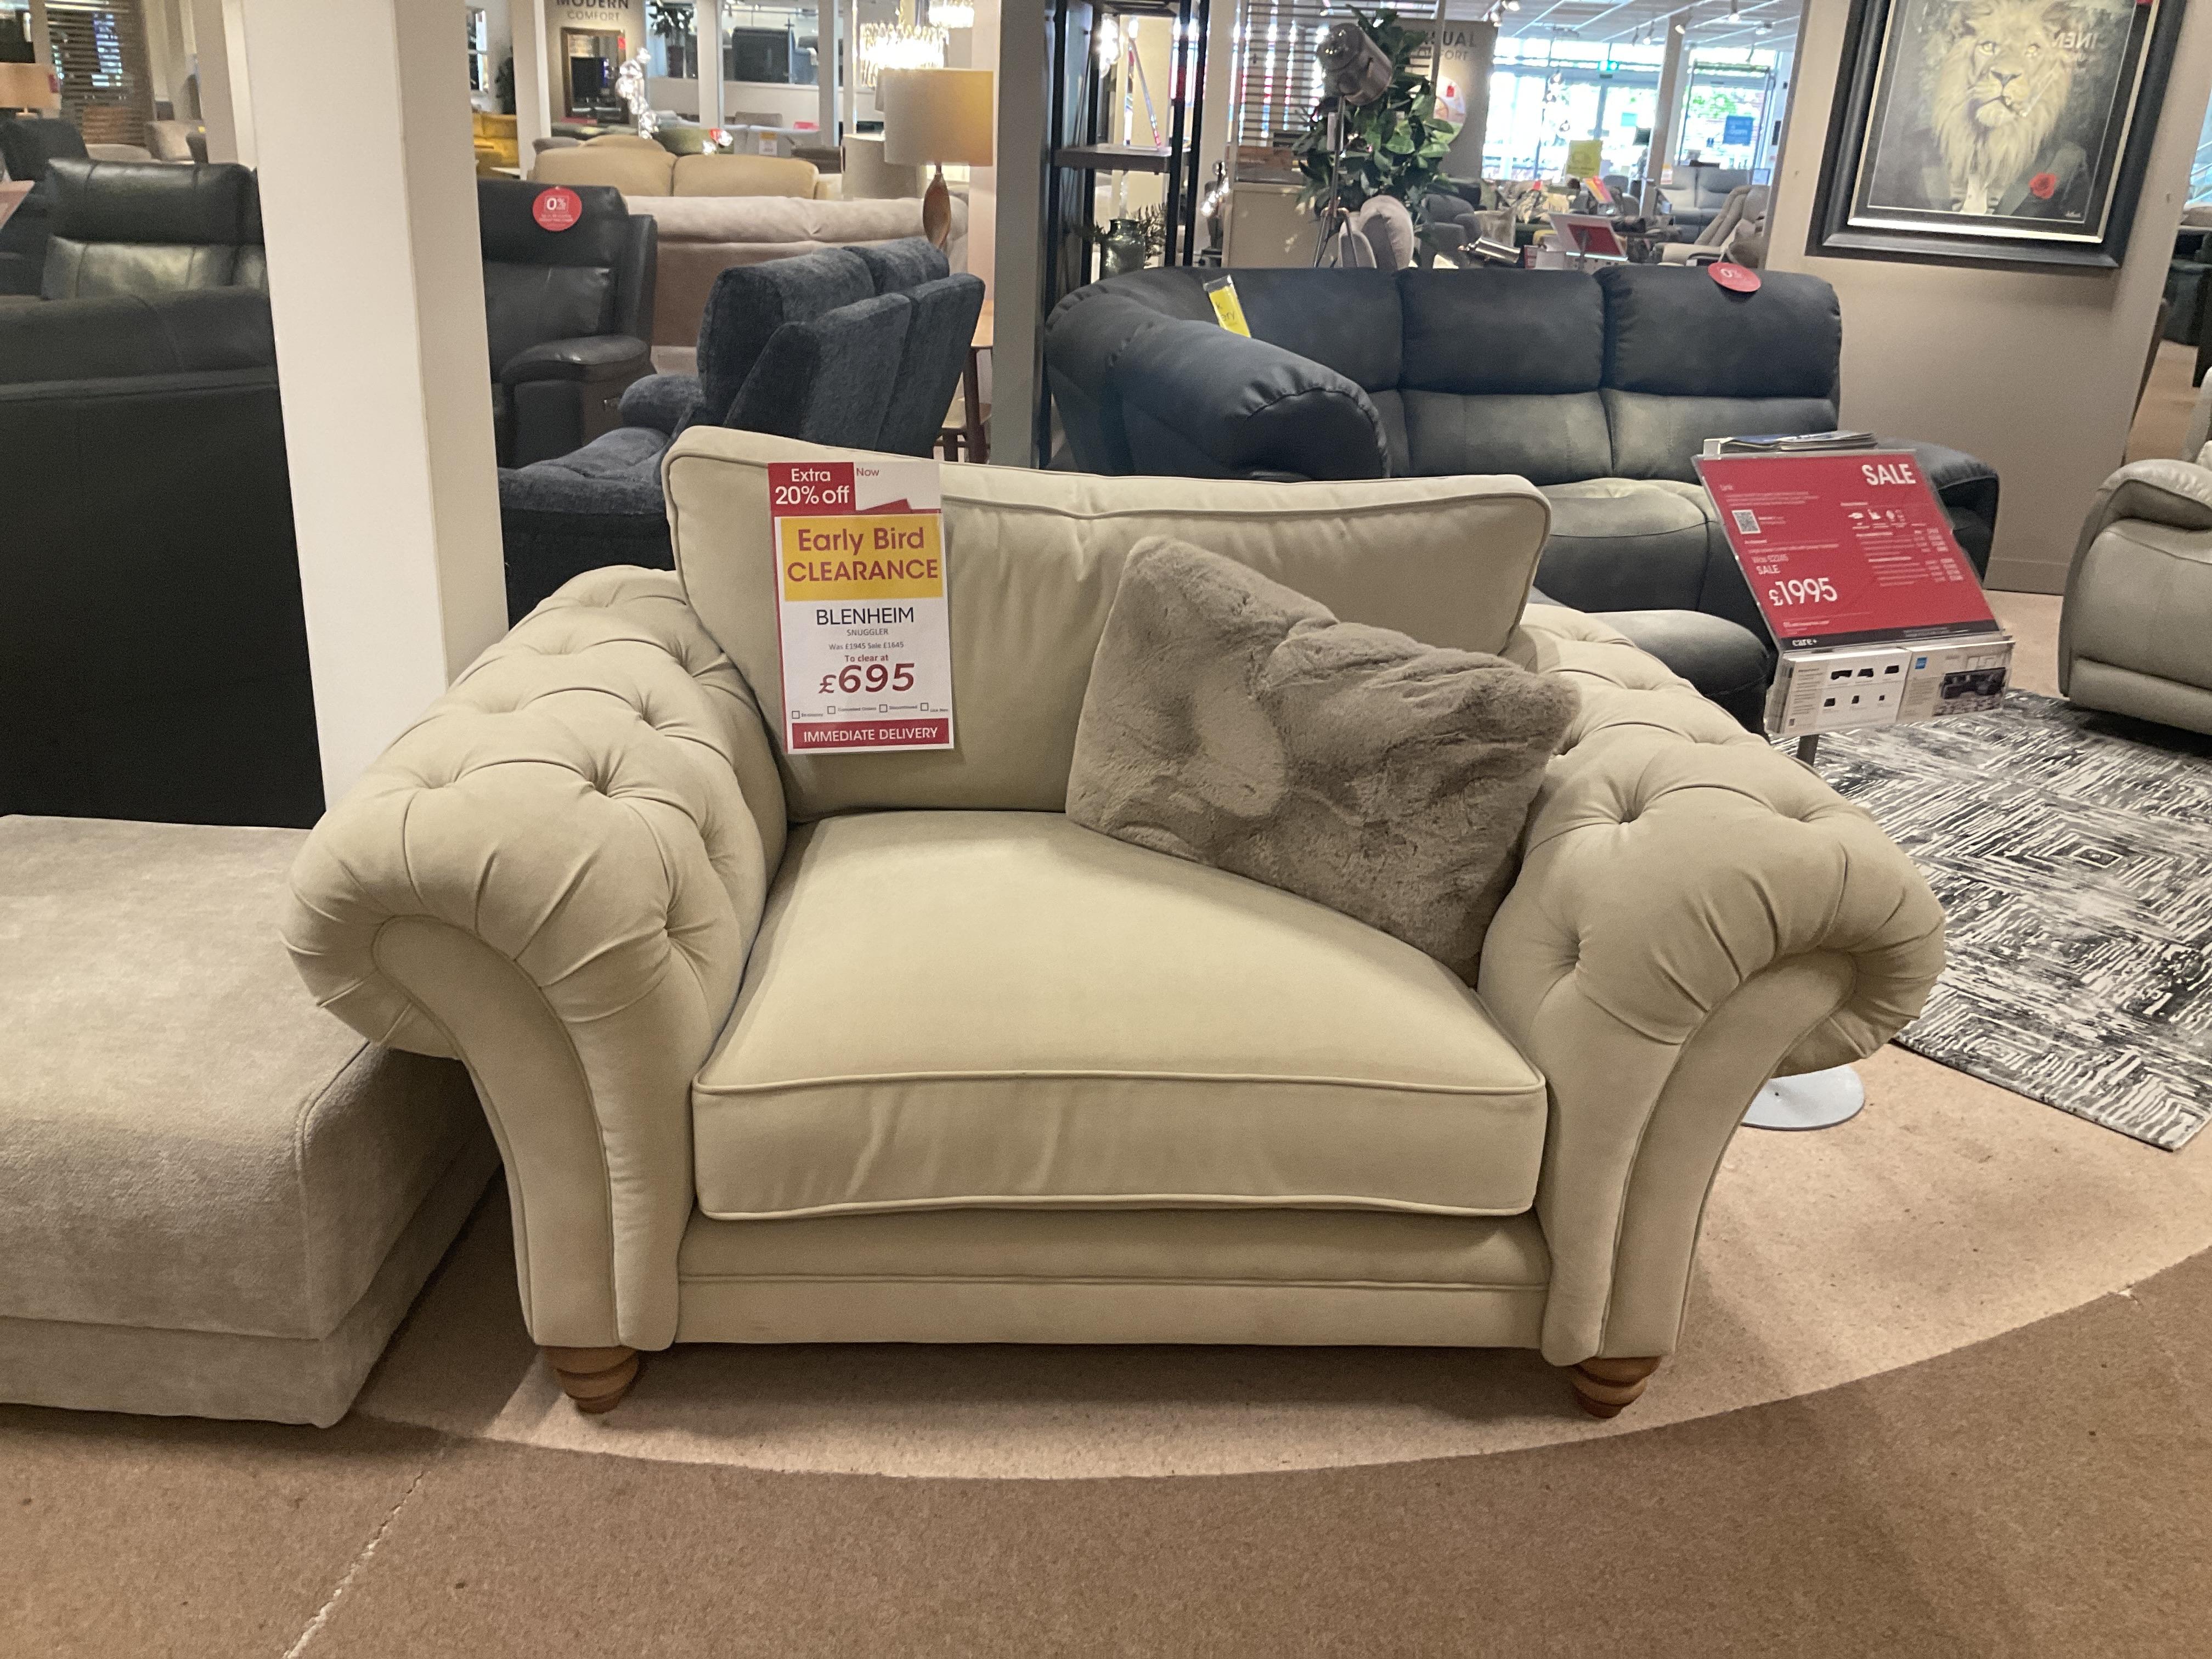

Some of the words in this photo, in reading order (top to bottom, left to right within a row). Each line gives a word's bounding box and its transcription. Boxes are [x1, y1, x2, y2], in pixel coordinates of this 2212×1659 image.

[567, 10, 619, 21] COMFORT
[791, 468, 831, 482] Extra
[856, 468, 879, 476] Now
[1861, 464, 1917, 486] SALE
[775, 486, 820, 505] 20%
[822, 485, 850, 504] off
[798, 528, 864, 556] Early
[873, 527, 924, 550] Bird
[787, 558, 938, 582] CLEARANCE
[1756, 565, 1781, 575] SALE
[1768, 577, 1838, 606] £1995
[816, 607, 915, 625] BLENHEIM
[847, 628, 889, 636] SNUGGLER
[819, 663, 915, 694] £695
[804, 729, 875, 743] IMMEDIATE
[879, 727, 938, 740] DELIVERY
